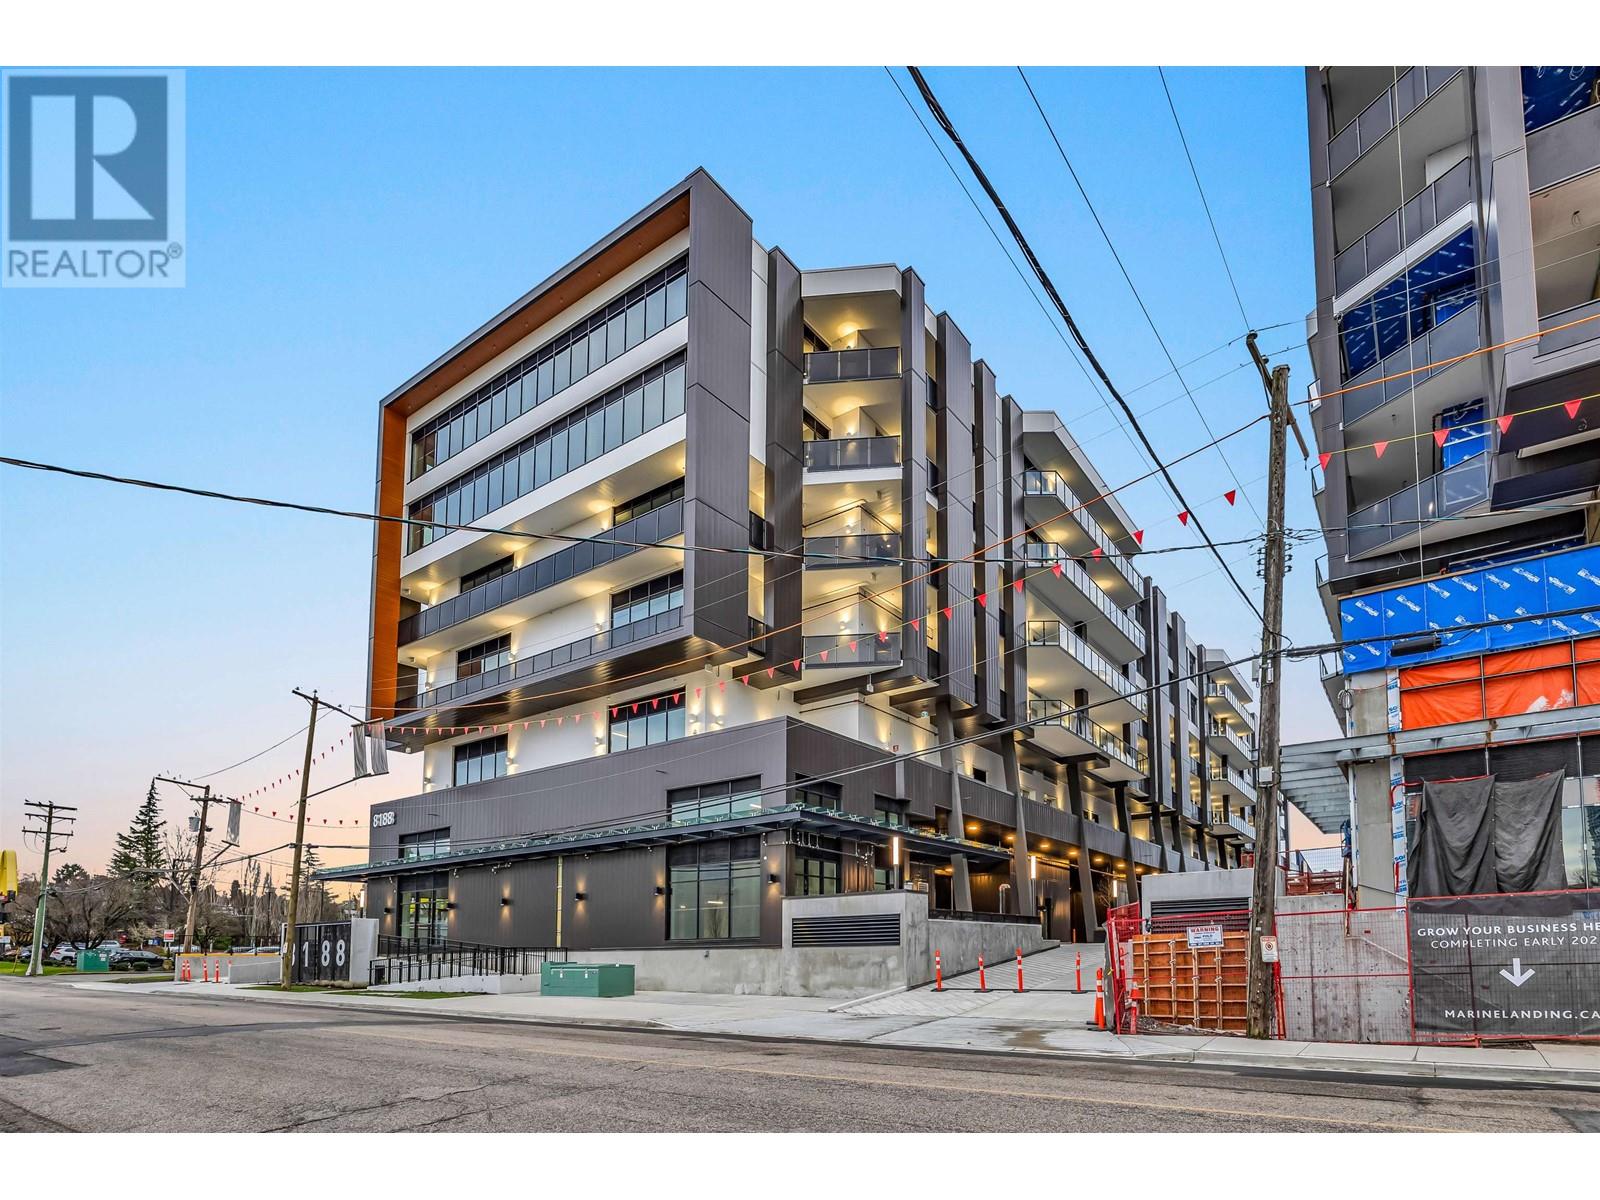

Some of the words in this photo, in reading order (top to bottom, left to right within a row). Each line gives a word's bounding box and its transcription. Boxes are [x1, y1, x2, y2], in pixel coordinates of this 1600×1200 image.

[373, 811, 395, 828] 8188
[1417, 927, 1459, 937] GROW
[1463, 926, 1502, 935] YOUR
[1507, 922, 1578, 934] BUSINESS
[1431, 938, 1518, 949] COMPLETING
[1524, 936, 1565, 947] EARLY
[1571, 935, 1598, 945] 202
[1444, 1009, 1600, 1019] MARINELANDING.CA
